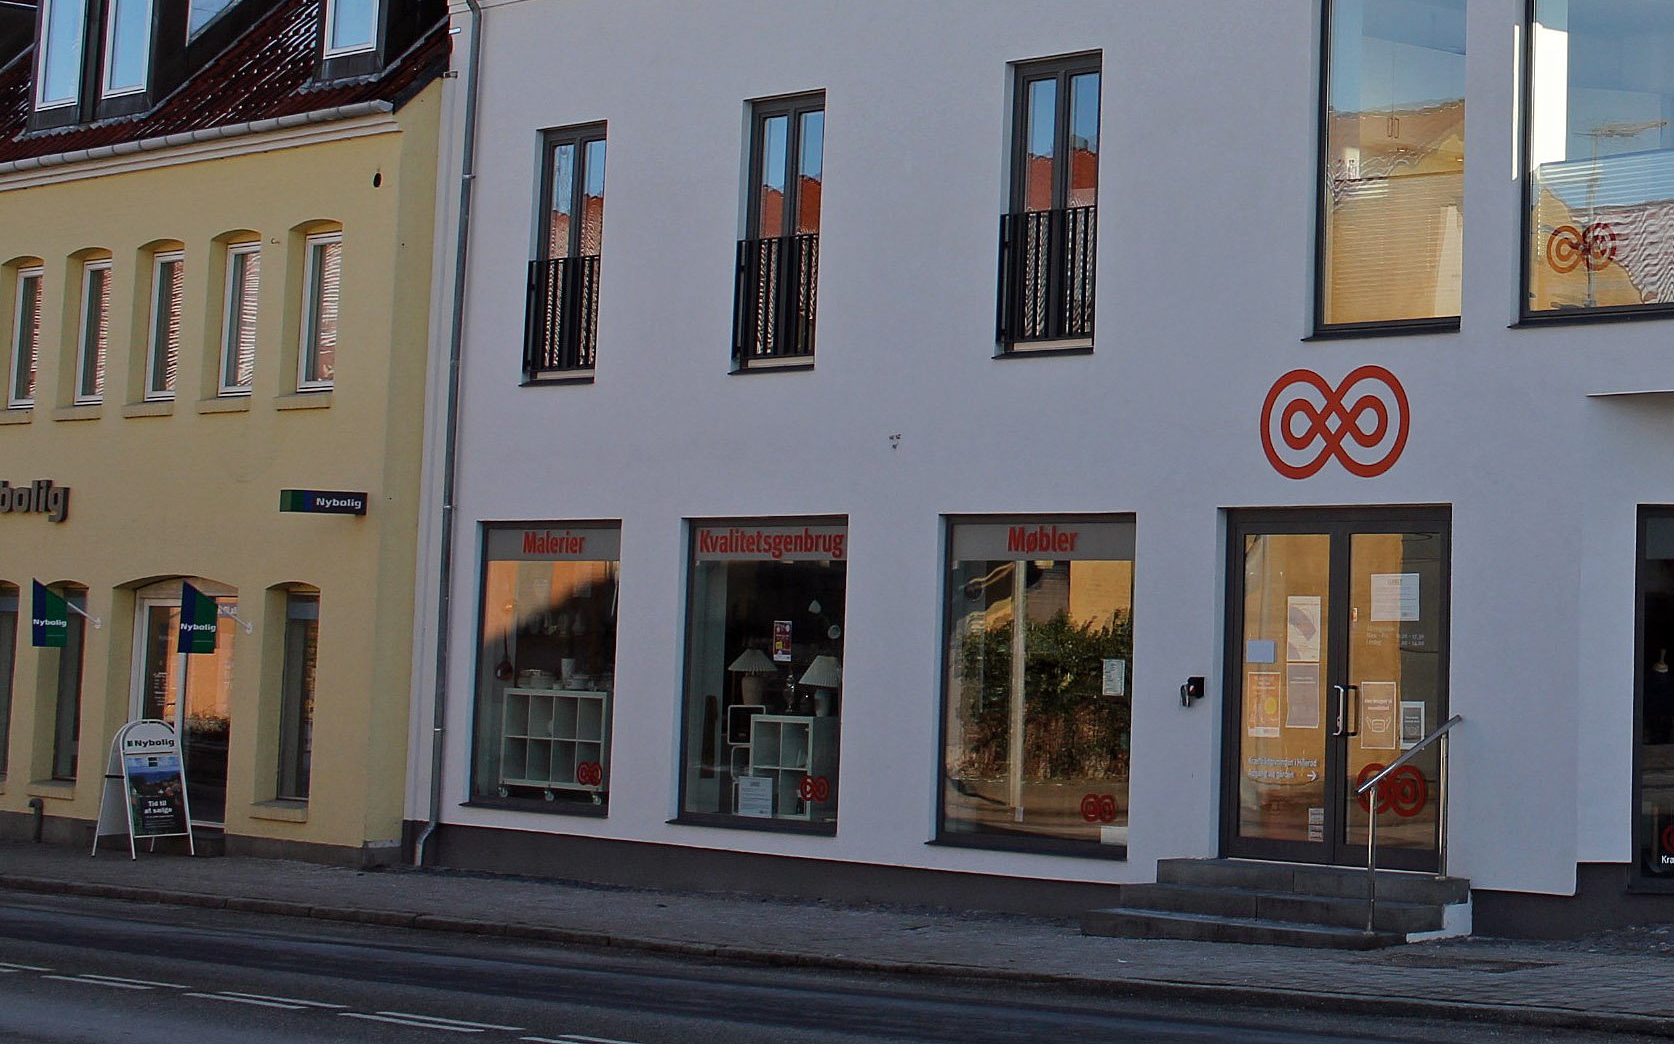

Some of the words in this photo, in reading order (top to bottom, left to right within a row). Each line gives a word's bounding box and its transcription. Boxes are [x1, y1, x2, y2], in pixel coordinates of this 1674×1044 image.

[316, 497, 362, 509] Nybolig
[522, 530, 585, 555] Malerier
[698, 527, 846, 558] Kvalitetsgenbrug
[1007, 525, 1079, 553] Møbler
[33, 619, 67, 627] Nybolig
[180, 623, 216, 632] Nybolig
[134, 738, 175, 747] Nybolig
